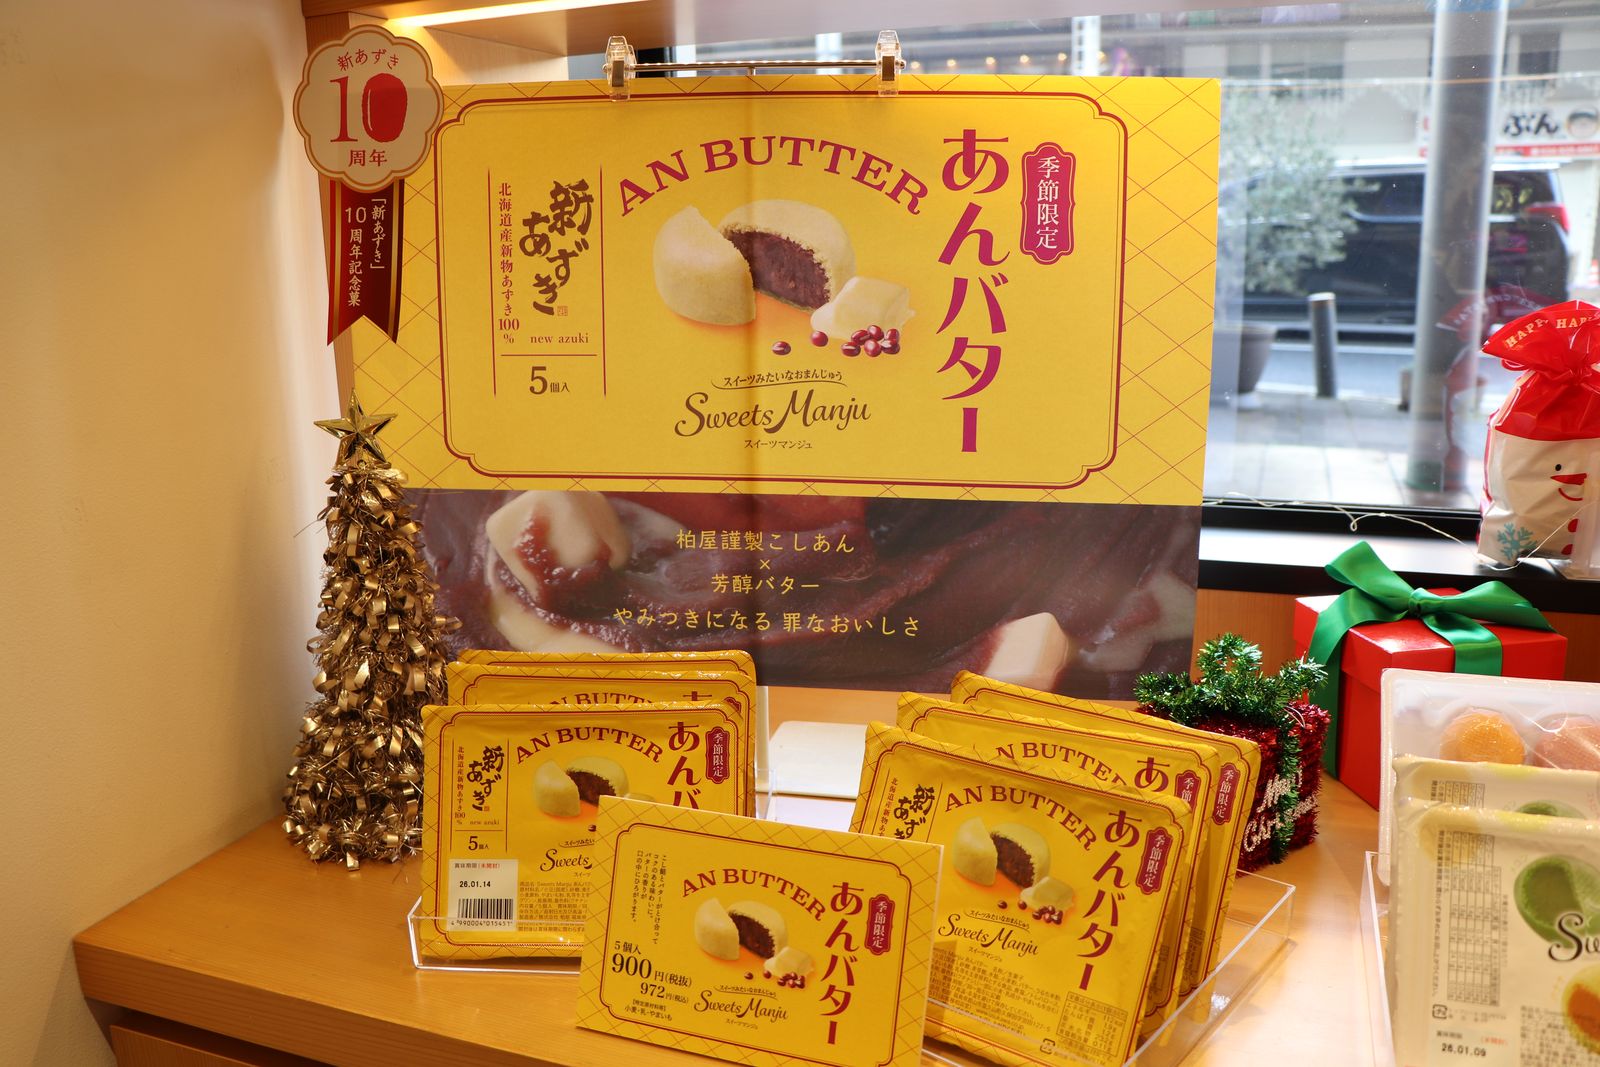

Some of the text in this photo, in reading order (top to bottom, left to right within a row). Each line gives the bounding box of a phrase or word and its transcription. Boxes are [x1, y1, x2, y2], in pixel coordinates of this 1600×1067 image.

[337, 48, 400, 71] 新あずき
[348, 149, 388, 167] 周年
[618, 135, 928, 217] AN BUTTER
[1035, 155, 1060, 250] 季節限定
[345, 206, 367, 307] 10周年記念菓
[370, 198, 387, 270] 「新あずき」
[518, 179, 594, 316] 新あずき
[935, 129, 1010, 452] あんバター
[530, 332, 589, 344] new azuki
[529, 365, 571, 395] 5個入
[723, 369, 843, 388] スイーツみたいなおまんじゅう
[674, 389, 872, 436] Sweets Manju
[744, 439, 813, 450] スイーツマンジュ
[676, 529, 855, 553] 柏屋謹製こしあん
[711, 574, 820, 595] 芳醇バター
[613, 608, 920, 637] やみつきになる 罪なおいしさ
[516, 726, 664, 765] AN BUTTER
[712, 732, 724, 777] 季節限定
[467, 745, 504, 811] 新あずき
[1216, 770, 1235, 819] 季節限定
[945, 785, 1097, 851] AN BUTTER
[540, 848, 590, 871] Sweets
[1144, 834, 1166, 888] 季節限定
[459, 880, 491, 888] 26.01.14
[682, 868, 826, 922] AN BUTTER
[1075, 809, 1141, 991] あんバター
[871, 900, 888, 949] 季節限定
[938, 913, 1039, 957] Sweets Manju
[614, 941, 642, 955] 5個入
[819, 881, 864, 1045] あんバター
[693, 989, 788, 1023] Sweets Manju
